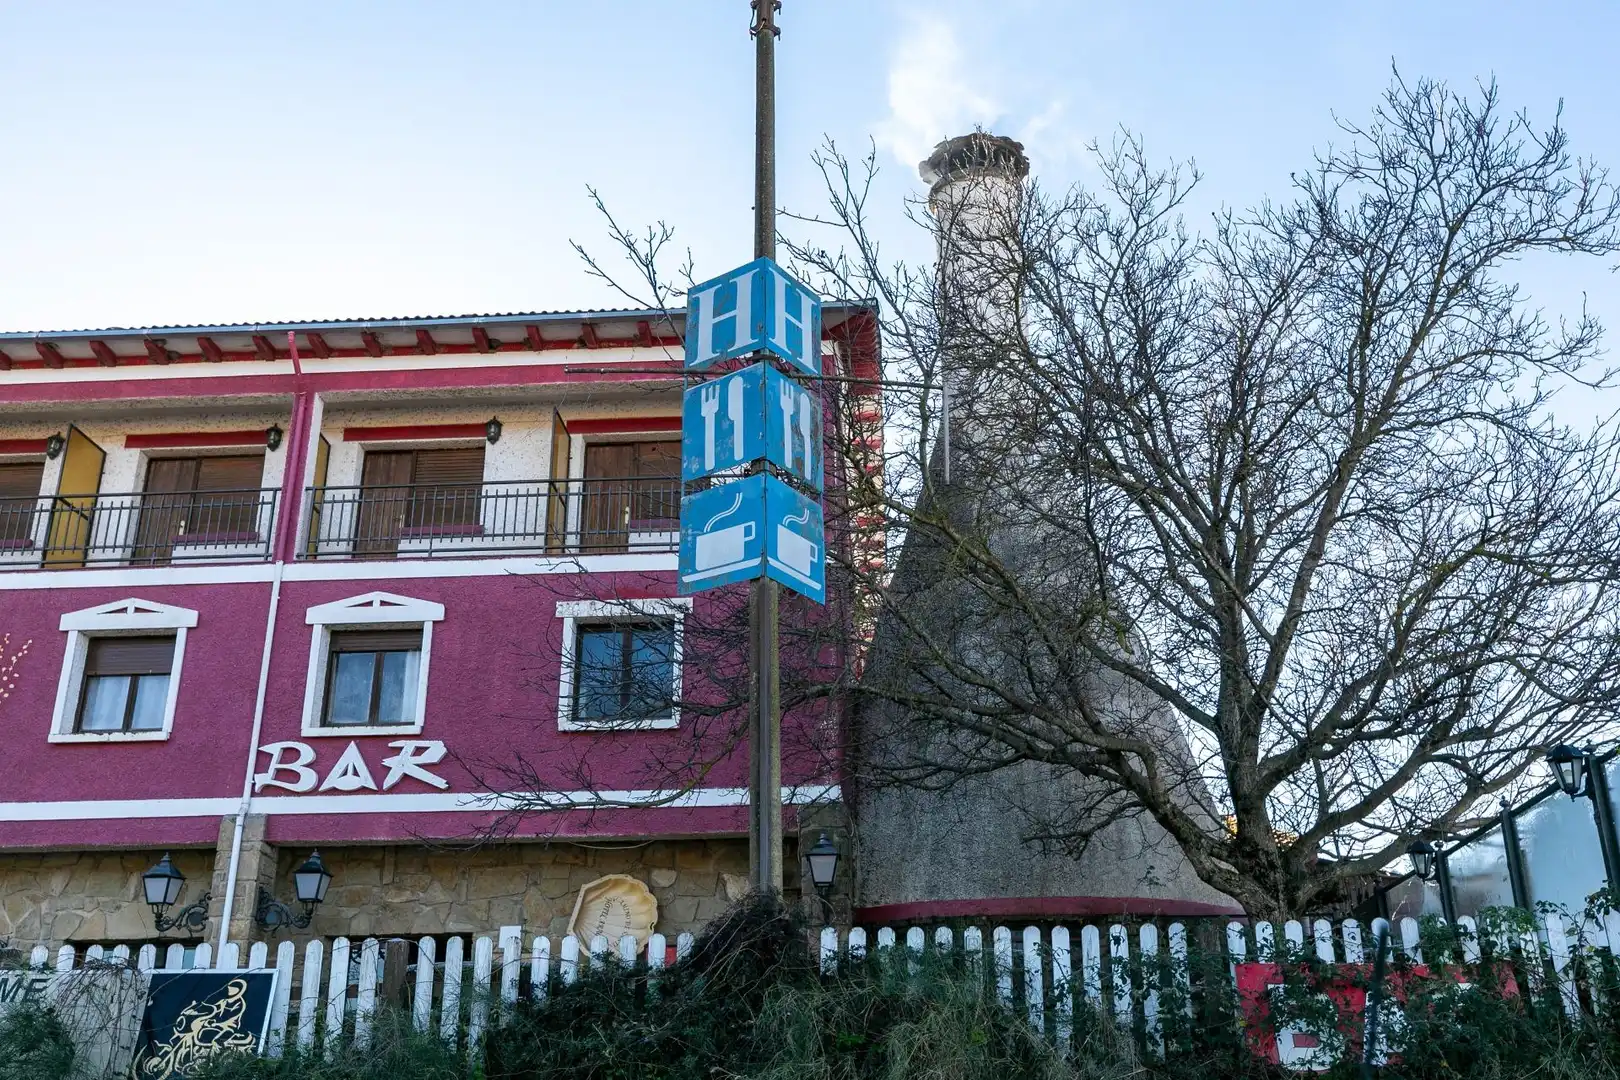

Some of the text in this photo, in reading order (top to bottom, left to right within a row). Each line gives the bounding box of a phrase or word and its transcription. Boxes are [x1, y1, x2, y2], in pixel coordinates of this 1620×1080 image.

[689, 268, 760, 367] H
[768, 267, 818, 374] H
[254, 740, 449, 794] BAR
